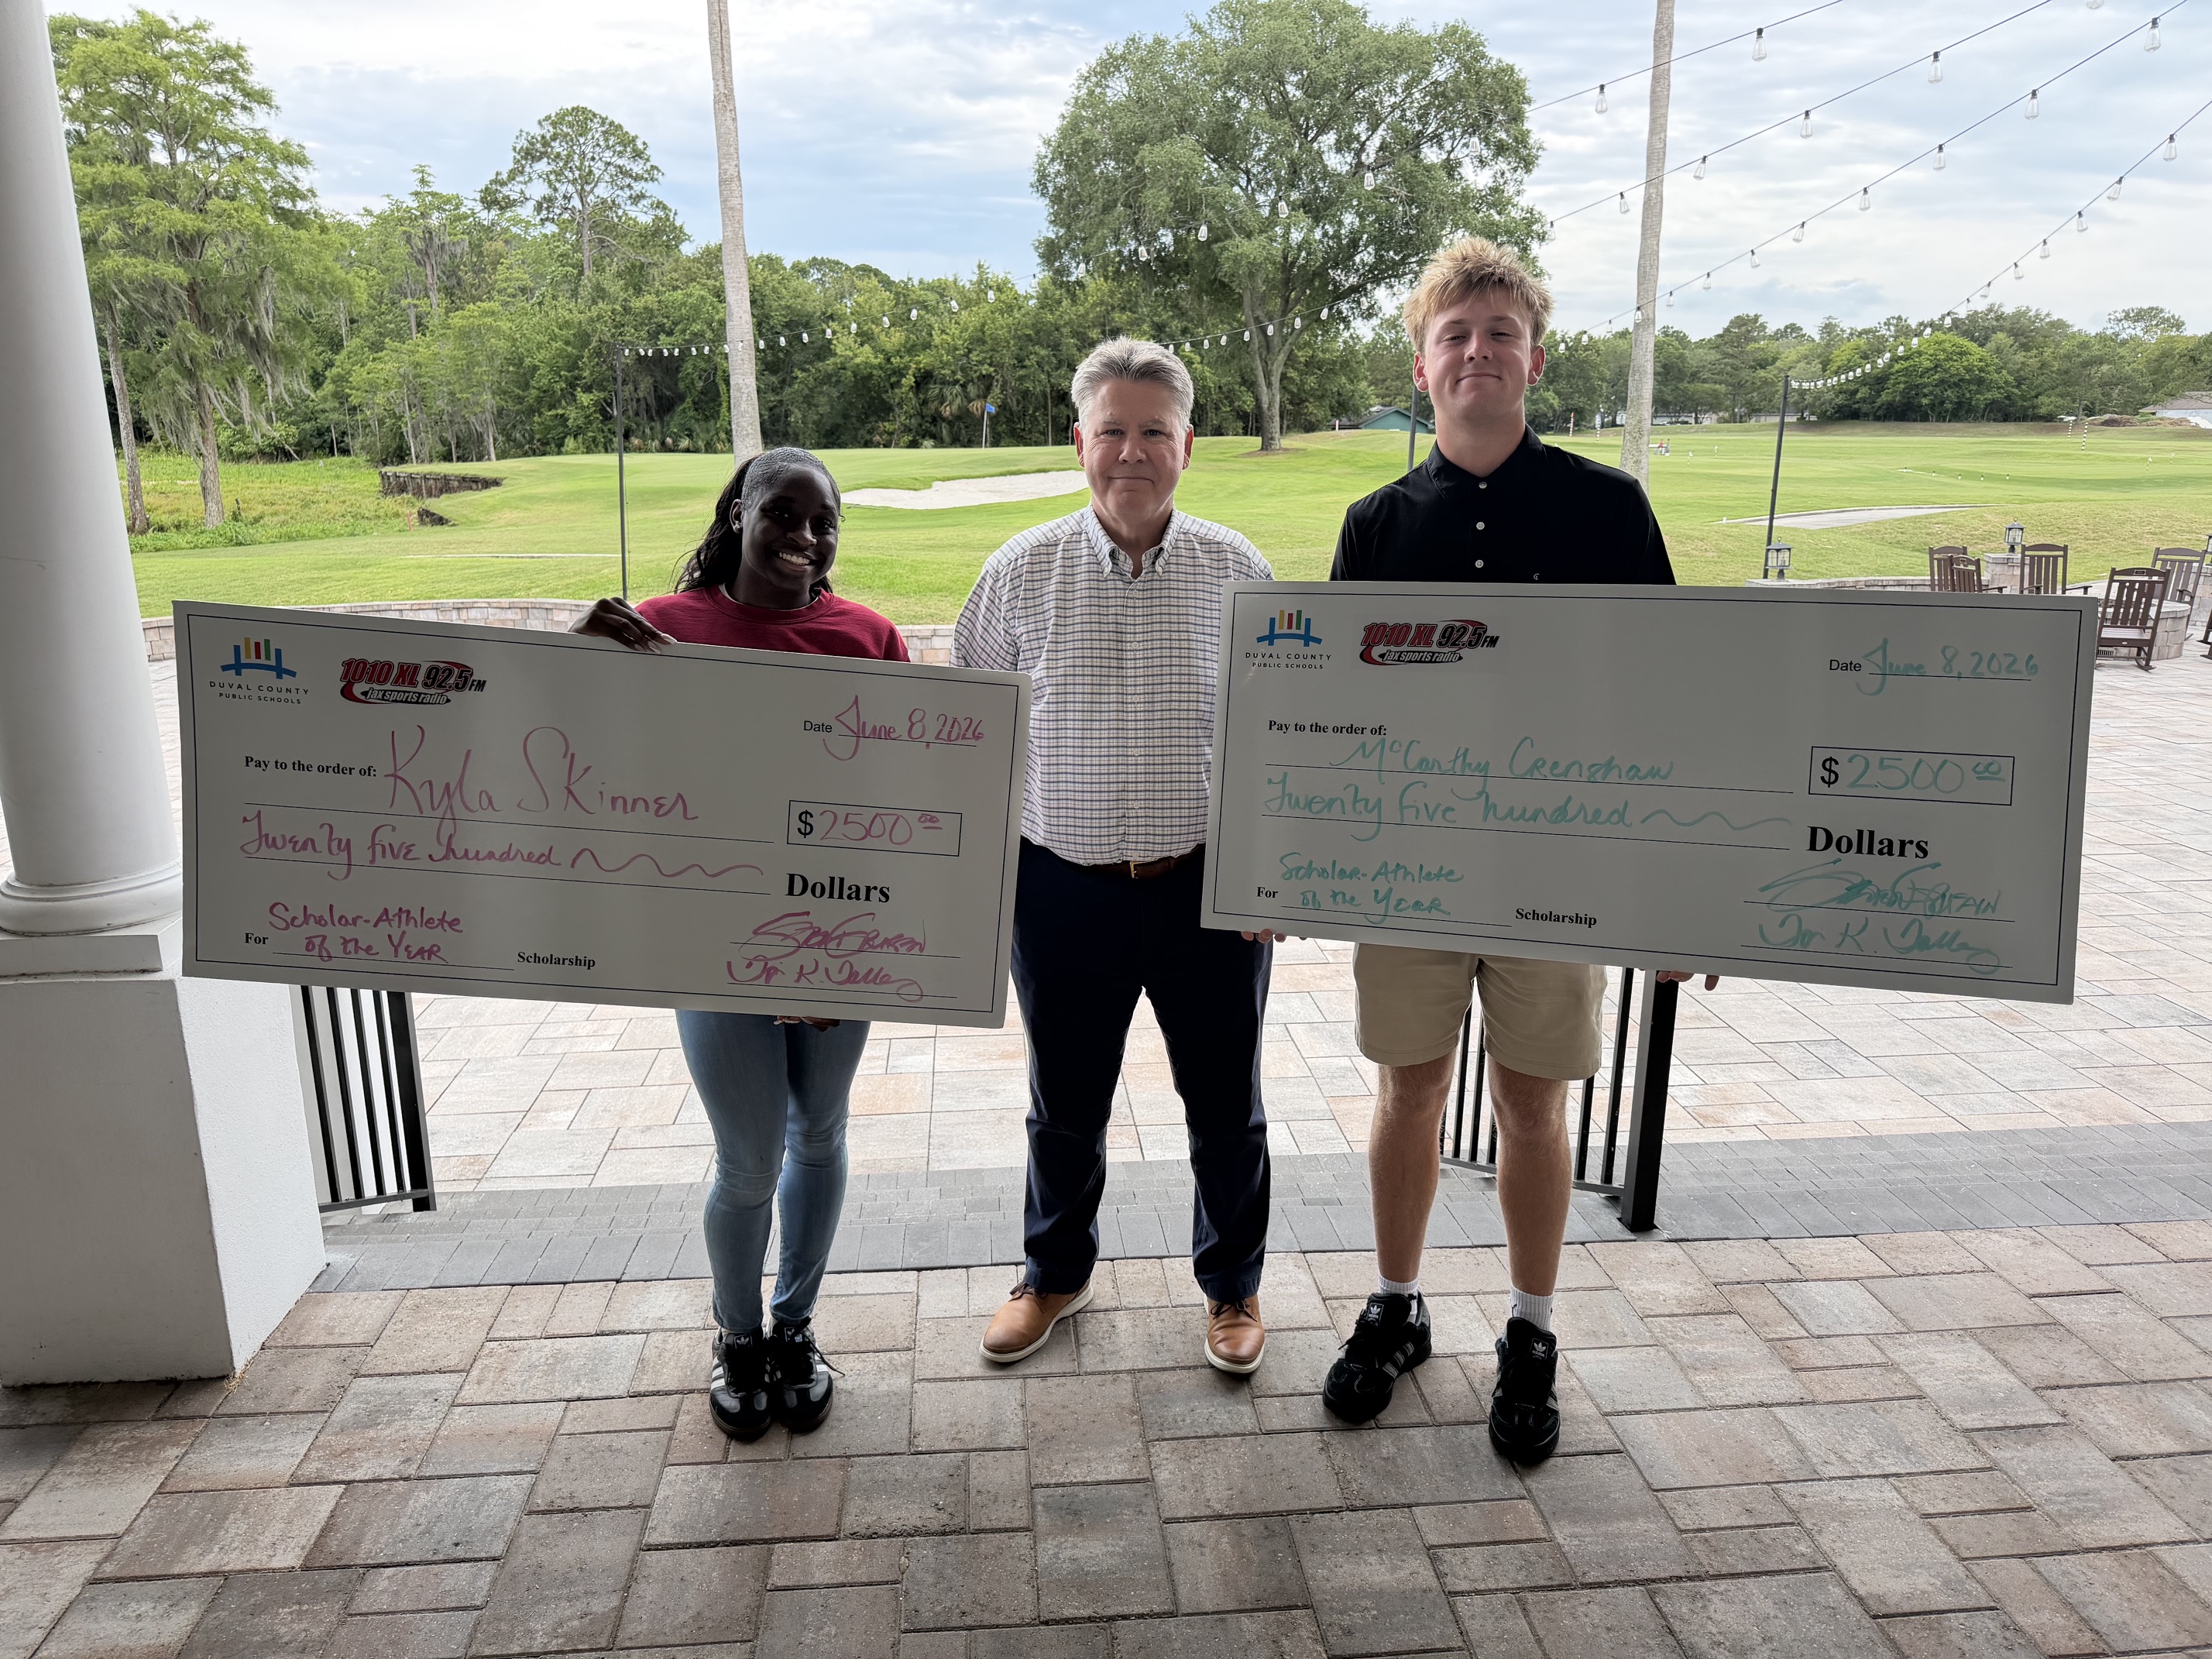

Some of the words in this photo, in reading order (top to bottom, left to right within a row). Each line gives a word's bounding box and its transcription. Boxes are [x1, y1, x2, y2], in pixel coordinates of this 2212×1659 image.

[1361, 623, 1412, 647] 1010
[1408, 623, 1437, 647] XL
[1383, 650, 1400, 661] jax
[1400, 651, 1433, 662] sports
[1431, 651, 1461, 663] radio
[1829, 658, 1862, 673] Date
[1856, 637, 1926, 696] June
[340, 658, 394, 685] 1010
[391, 662, 421, 688] XL
[209, 681, 252, 691] DUVAL
[257, 685, 309, 696] COUNTY
[366, 687, 386, 700] jax
[386, 690, 419, 702] sports
[417, 693, 448, 705] radio
[257, 696, 301, 704] SCHOOLS
[803, 720, 833, 734] Date
[823, 695, 902, 761] June
[1268, 720, 1291, 734] Pay
[1293, 723, 1307, 733] to
[1310, 721, 1328, 735] the
[1331, 722, 1368, 737] order
[1369, 723, 1387, 737] of:
[244, 756, 270, 771] Pay
[273, 759, 288, 771] to
[292, 759, 312, 773] the
[314, 761, 356, 777] order
[359, 764, 377, 778] of:
[384, 725, 502, 846] Kyla
[1264, 772, 1382, 841] Twenty
[1397, 781, 1457, 826] five
[1480, 789, 1633, 827] hundred
[240, 810, 353, 881] Twenty
[368, 824, 421, 865] five
[428, 835, 562, 867] hundred
[1806, 826, 1930, 860] Dollars
[785, 873, 891, 904] Dollars
[1255, 886, 1279, 900] For
[1515, 907, 1598, 927] Scholarship
[244, 932, 269, 945] For
[517, 950, 596, 970] Scholarship
